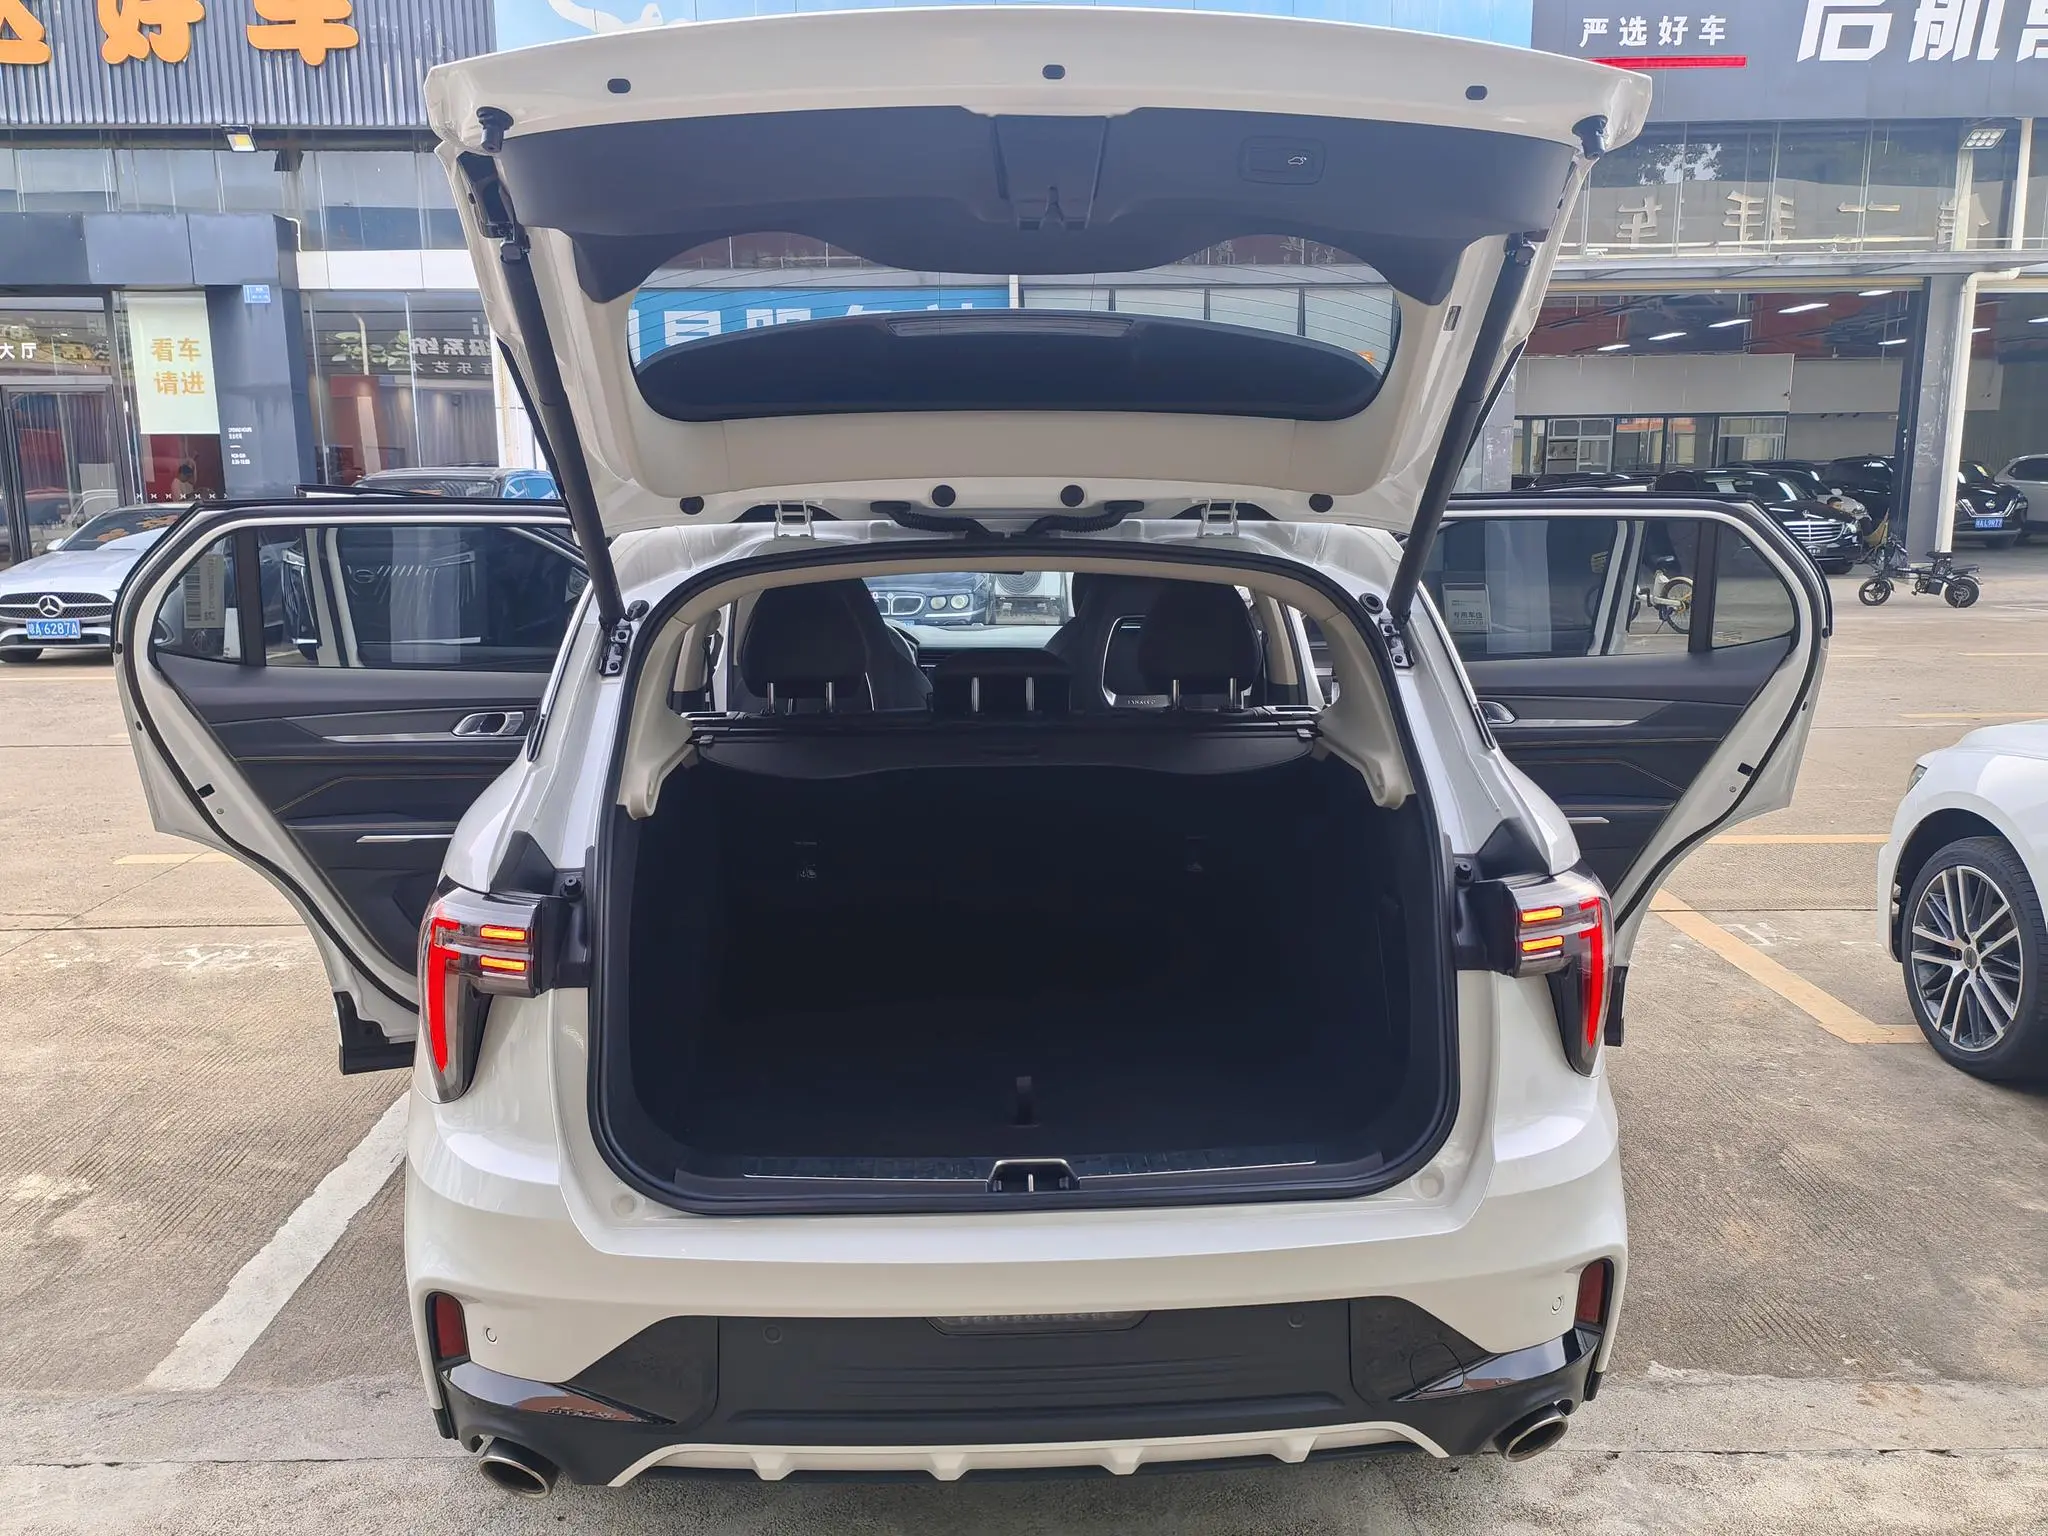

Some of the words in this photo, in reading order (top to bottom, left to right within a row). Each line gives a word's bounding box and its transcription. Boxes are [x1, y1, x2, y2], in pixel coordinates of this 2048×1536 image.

[1579, 15, 1727, 47] 严选好车
[151, 337, 201, 363] 看车
[154, 371, 205, 396] 请进
